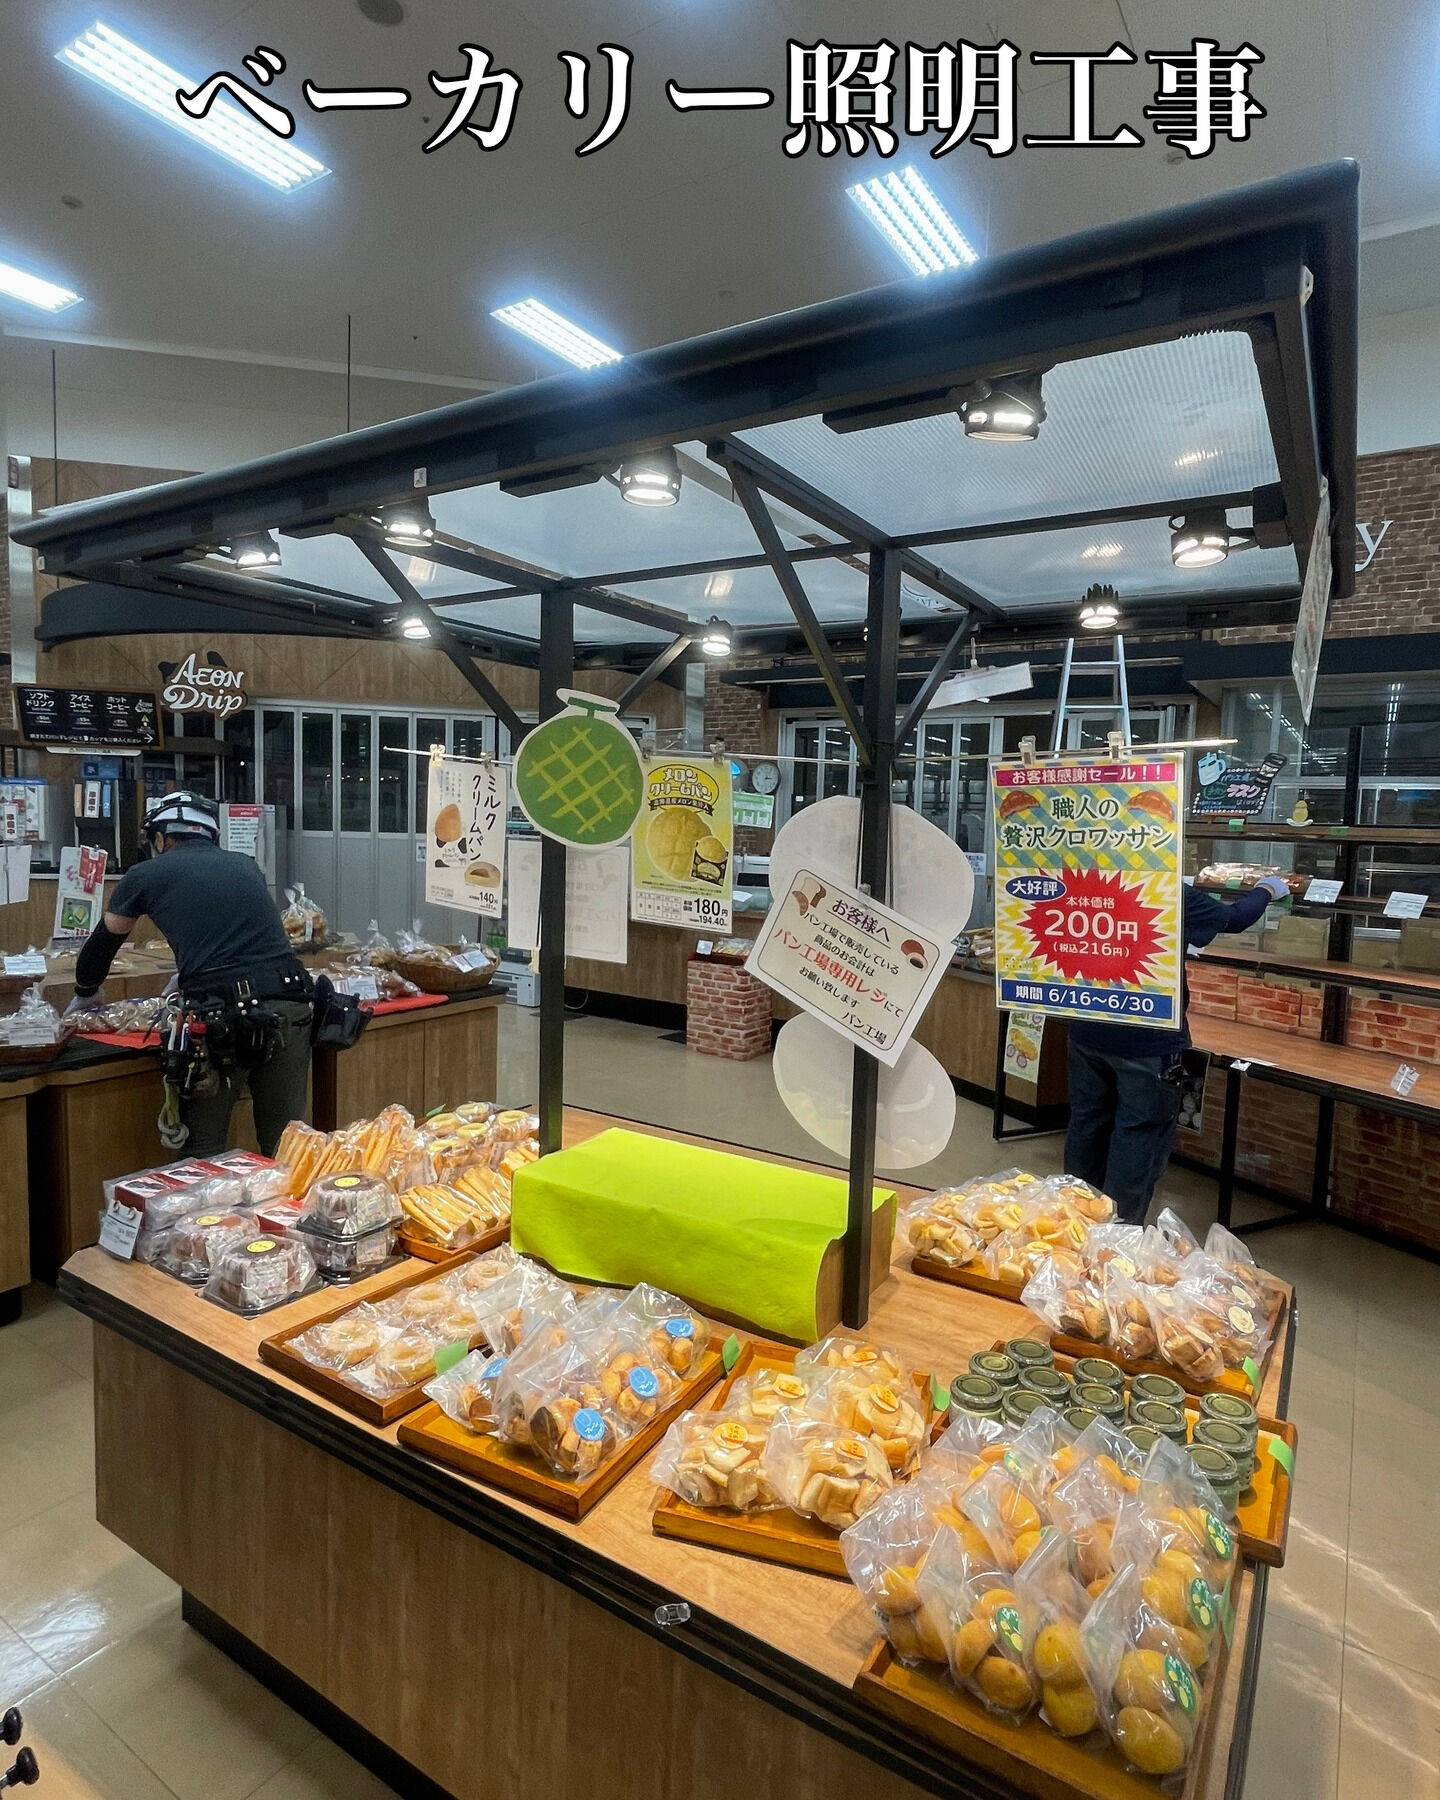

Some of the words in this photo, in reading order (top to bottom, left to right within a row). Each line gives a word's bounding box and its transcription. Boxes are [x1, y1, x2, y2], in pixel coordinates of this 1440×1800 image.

[163, 684, 243, 717] Drip
[650, 782, 713, 800] クリームパン
[663, 768, 698, 783] メロン
[1012, 766, 1161, 783] お客様感謝セール！！
[468, 775, 484, 861] クリームパン
[484, 774, 501, 831] ミルク
[1052, 797, 1120, 820] 職人の
[1002, 825, 1174, 849] 贅沢クロワッサン
[1012, 880, 1058, 896] 大好評
[1066, 897, 1115, 909] 本体価格
[832, 899, 890, 942] お客様へ
[1044, 909, 1139, 942] 200円
[804, 912, 900, 975] パン工場で販売している
[814, 934, 877, 977] 商品のお会計は
[774, 928, 904, 1018] パン工場専用レジにて
[800, 966, 860, 1008] お願い致します
[1015, 985, 1043, 1001] 期間
[843, 1011, 888, 1045] パン工場
